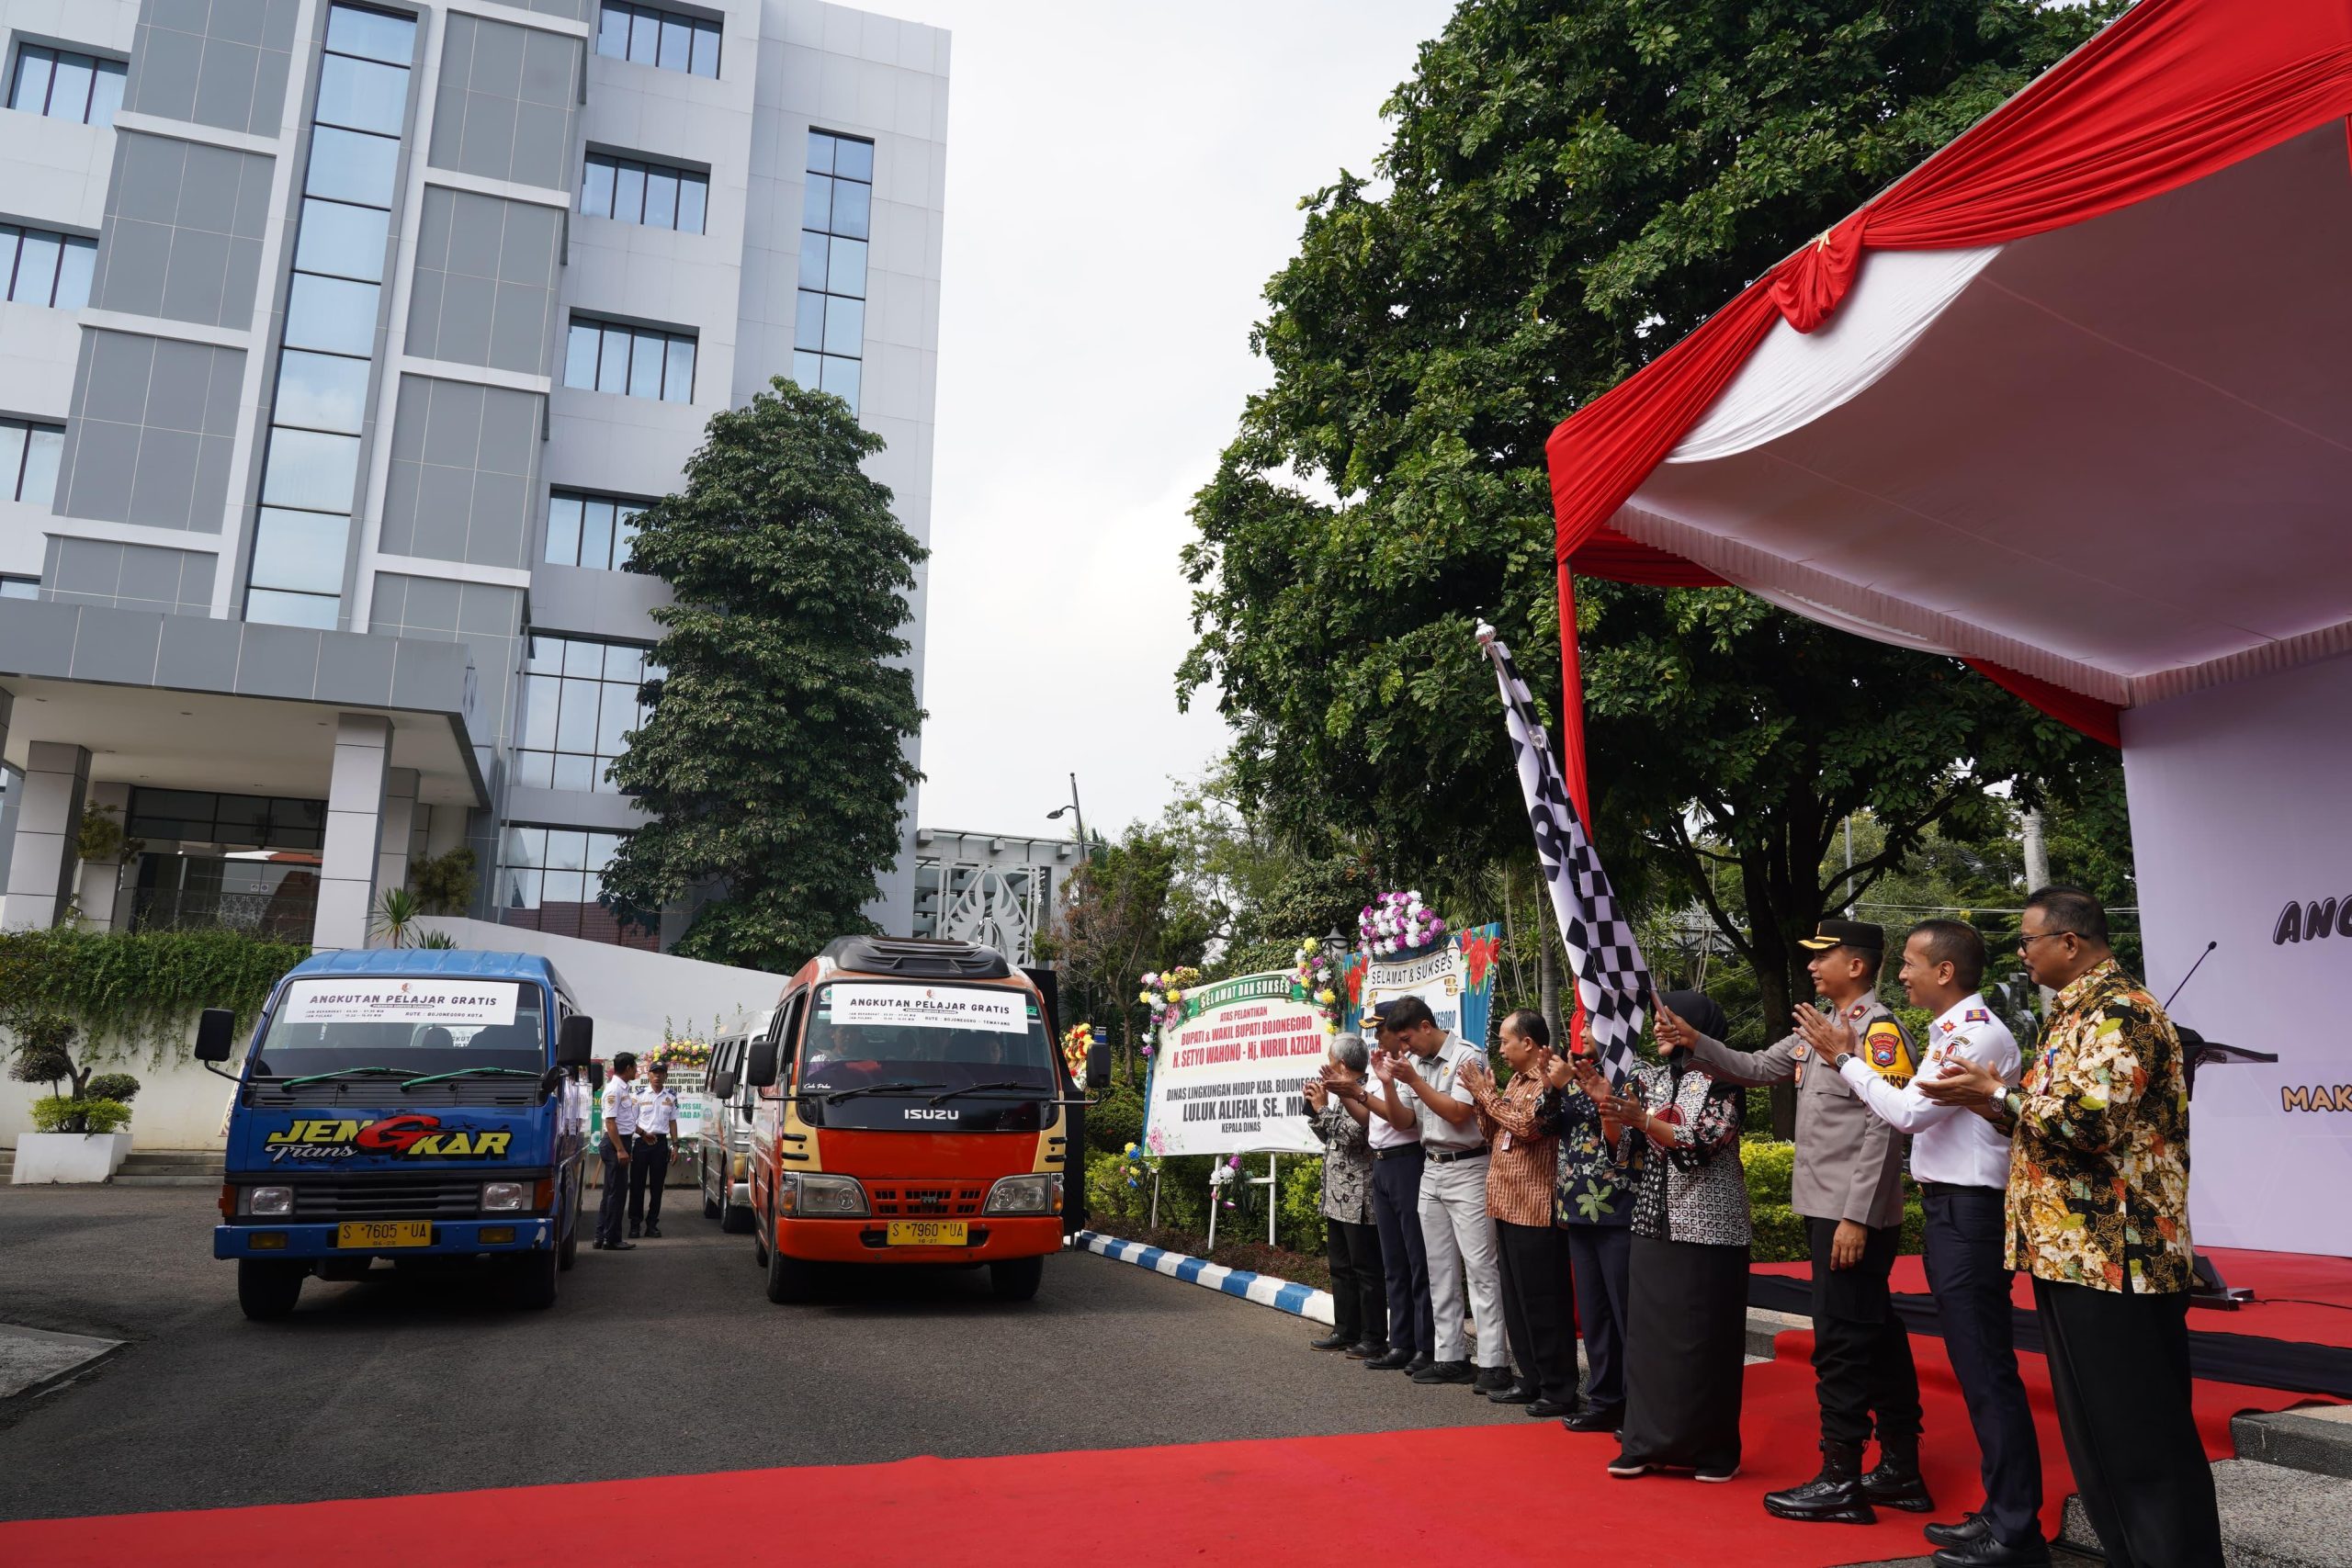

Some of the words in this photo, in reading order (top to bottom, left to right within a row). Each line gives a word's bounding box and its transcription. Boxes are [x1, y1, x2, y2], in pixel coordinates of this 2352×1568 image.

[1372, 970, 1408, 985] SELAMAT
[1408, 968, 1414, 982] &
[1416, 955, 1453, 981] SUKSES
[310, 995, 380, 1003] ANGKUTAN
[386, 995, 446, 1004] PELAJAR
[451, 997, 497, 1006] GRATIS
[1200, 986, 1238, 1009] SELAMAT
[1238, 983, 1255, 997] DAN
[1256, 979, 1291, 994] SUKSES
[850, 998, 910, 1008] ANGKUTAN
[915, 1000, 967, 1010] PELAJAR
[971, 1004, 1010, 1014] GRATIS
[1220, 1010, 1234, 1022] ATAS
[1234, 1006, 1268, 1021] PELANTIKAN
[1182, 1030, 1204, 1045] BUPATI
[1205, 1030, 1210, 1042] &
[1212, 1027, 1234, 1041] WAKIL
[1235, 1022, 1261, 1038] BUPATI
[1262, 1015, 1312, 1034] BOJONEGORO
[1172, 1051, 1180, 1068] H.
[1182, 1047, 1204, 1067] SETYO
[1206, 1043, 1241, 1064] WAHONO
[1248, 1041, 1258, 1061] Hj.
[1261, 1038, 1288, 1058] NURUL
[1290, 1034, 1321, 1055] AZIZAH
[1166, 1088, 1187, 1101] DINAS
[1188, 1083, 1231, 1100] LINGKUNGAN
[1232, 1080, 1255, 1096] HIDUP
[1257, 1080, 1274, 1094] KAB.
[904, 1109, 959, 1120] ISUZU
[1183, 1101, 1216, 1122] LULUK
[1218, 1099, 1261, 1120] ALIFAH,
[1262, 1098, 1283, 1118] SE.,
[1221, 1122, 1241, 1134] KEPALA
[1243, 1122, 1261, 1133] DINAS
[266, 1144, 358, 1162] Trans
[344, 1225, 351, 1238] S
[366, 1224, 397, 1238] 7605
[411, 1224, 426, 1237] UA
[892, 1224, 899, 1236] S
[910, 1224, 938, 1236] 7960
[950, 1224, 963, 1236] UA
